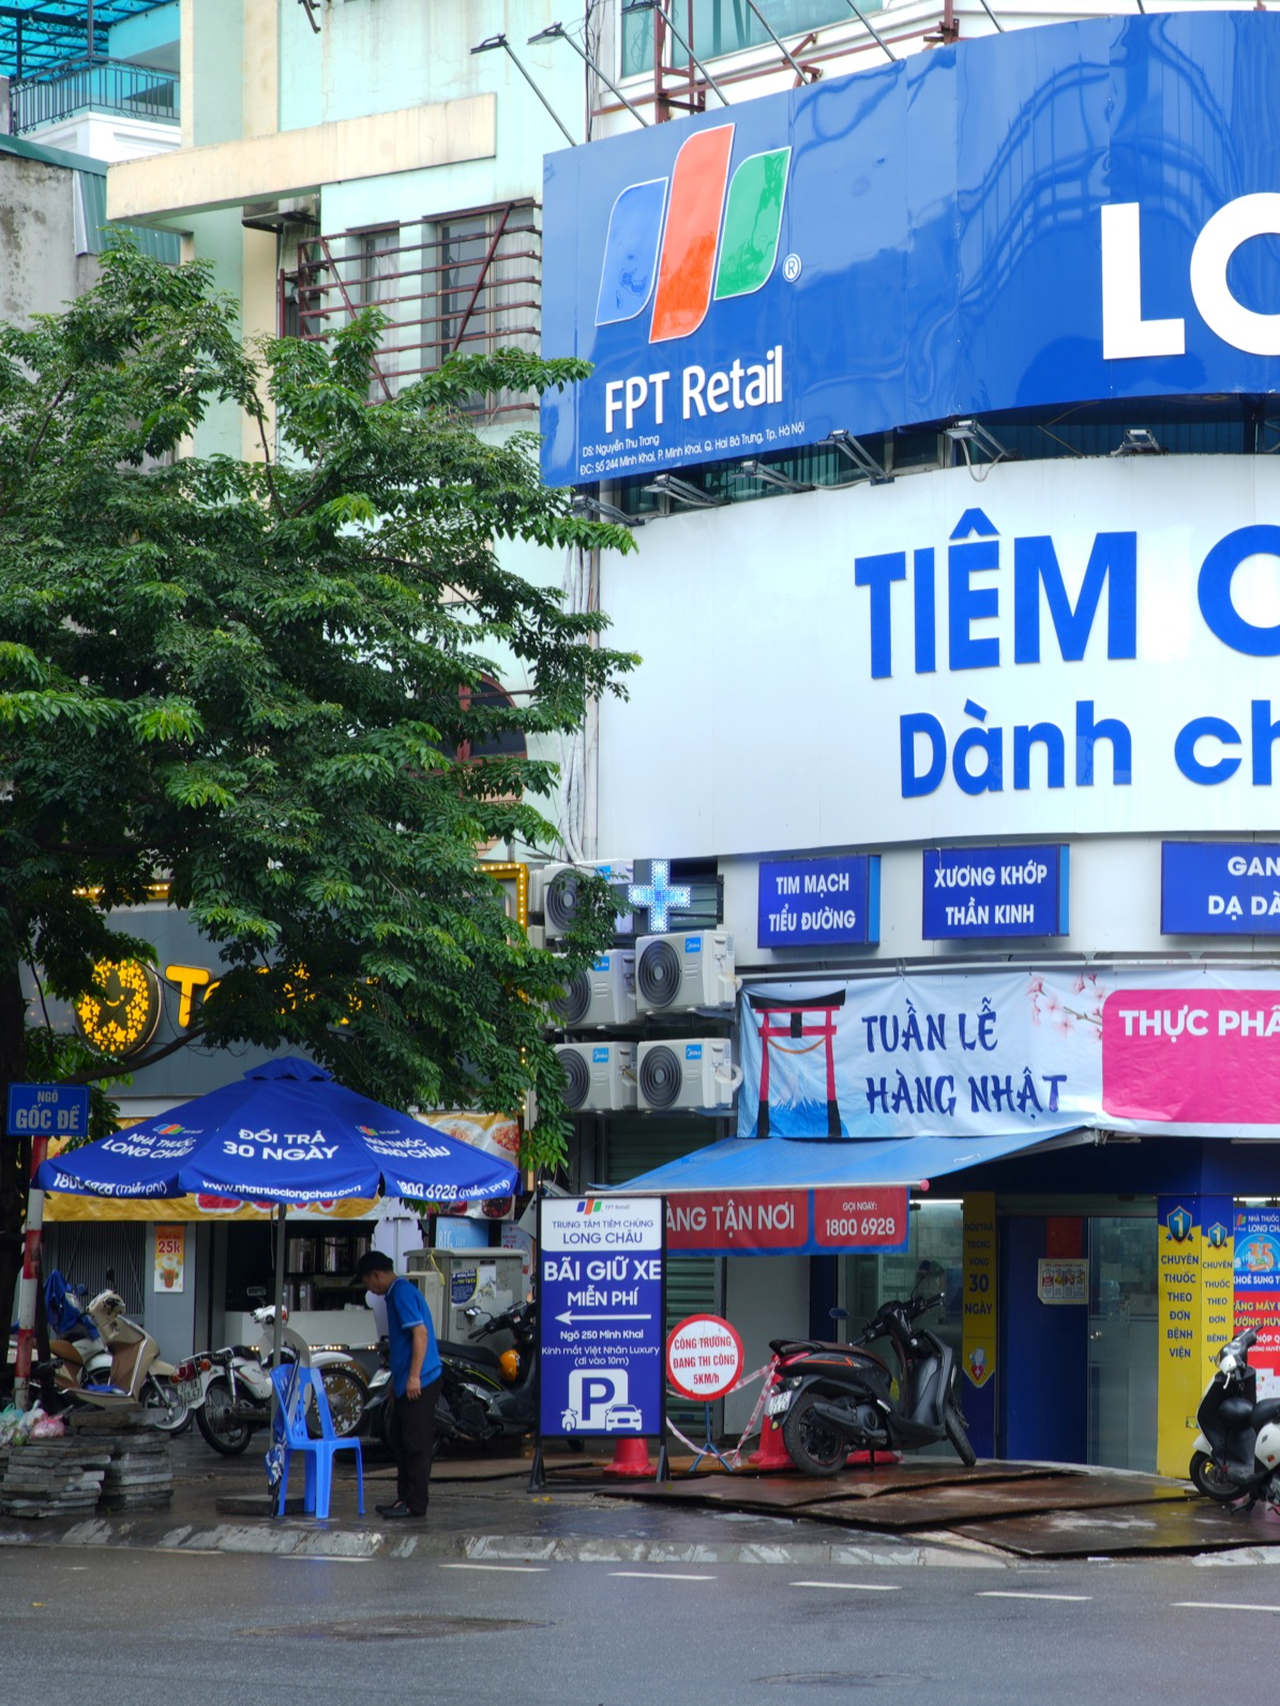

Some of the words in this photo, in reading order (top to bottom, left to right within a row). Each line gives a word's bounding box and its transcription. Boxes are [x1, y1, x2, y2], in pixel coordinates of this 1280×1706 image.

[605, 371, 671, 434] FPT
[682, 345, 783, 420] Retail
[582, 446, 594, 458] DS:
[596, 439, 624, 457] Nguyễn
[625, 438, 638, 450] Thu
[639, 435, 660, 449] Trang
[855, 508, 1137, 680] TIÊM
[900, 698, 1132, 799] Dành
[776, 875, 801, 895] TIM
[804, 872, 850, 897] MẠCH
[934, 864, 996, 889] XƯƠNG
[1000, 861, 1048, 886] KHỚP
[945, 899, 990, 927] THẦN
[994, 903, 1035, 925] KINH
[1207, 895, 1243, 922] DẠ
[768, 908, 797, 933] TIỂU
[801, 904, 856, 932] ĐƯỜNG
[861, 997, 946, 1052] TUẦN
[958, 996, 999, 1051] LỄ
[1119, 1004, 1209, 1042] THỰC
[37, 1089, 59, 1104] NGÕ
[865, 1069, 956, 1116] HÀNG
[968, 1066, 1068, 1119] NHẬT
[16, 1103, 52, 1130] GỐC
[57, 1104, 81, 1131] ĐỀ
[238, 1128, 277, 1144] ĐỔI
[284, 1130, 326, 1145] TRẢ
[223, 1141, 255, 1158] 30
[262, 1145, 340, 1161] NGÀY
[842, 1202, 856, 1213] GỌI
[857, 1202, 877, 1211] NGAY:
[552, 1220, 580, 1229] TRUNG
[583, 1218, 600, 1229] TÂM
[603, 1218, 622, 1228] TIÊM
[623, 1217, 654, 1228] CHỦNG
[667, 1197, 707, 1231] ÀNG
[713, 1199, 753, 1238] TẬN
[758, 1202, 795, 1230] NƠI
[825, 1218, 857, 1236] 1800
[860, 1217, 895, 1236] 6928
[563, 1232, 602, 1244] LONG
[605, 1229, 643, 1244] CHÂU
[158, 1240, 181, 1254] 25k
[1160, 1251, 1199, 1265] CHUYÊN
[544, 1256, 580, 1281] BÃI
[586, 1255, 630, 1281] GIỮ
[633, 1259, 662, 1280] XE
[1163, 1270, 1197, 1284] THUỐC
[969, 1273, 990, 1294] 30
[567, 1284, 607, 1306] MIỄN
[611, 1286, 639, 1306] PHÍ
[1167, 1292, 1193, 1303] THEO
[964, 1301, 993, 1315] NGÀY
[1169, 1309, 1191, 1320] ĐƠN
[560, 1330, 580, 1342] Ngõ
[581, 1330, 598, 1339] 250
[599, 1329, 622, 1339] Minh
[623, 1329, 644, 1339] Khai
[674, 1337, 697, 1350] CÔNG
[700, 1335, 732, 1349] TRƯỜNG
[1167, 1326, 1193, 1342] BỆNH
[588, 1356, 606, 1366] vào
[607, 1356, 630, 1367] 10m)
[673, 1357, 696, 1369] ĐANG
[698, 1356, 711, 1367] THI
[713, 1353, 736, 1366] CÔNG
[1169, 1344, 1191, 1360] VIỆN
[693, 1373, 720, 1385] 5KM/h
[582, 1377, 615, 1421] P
